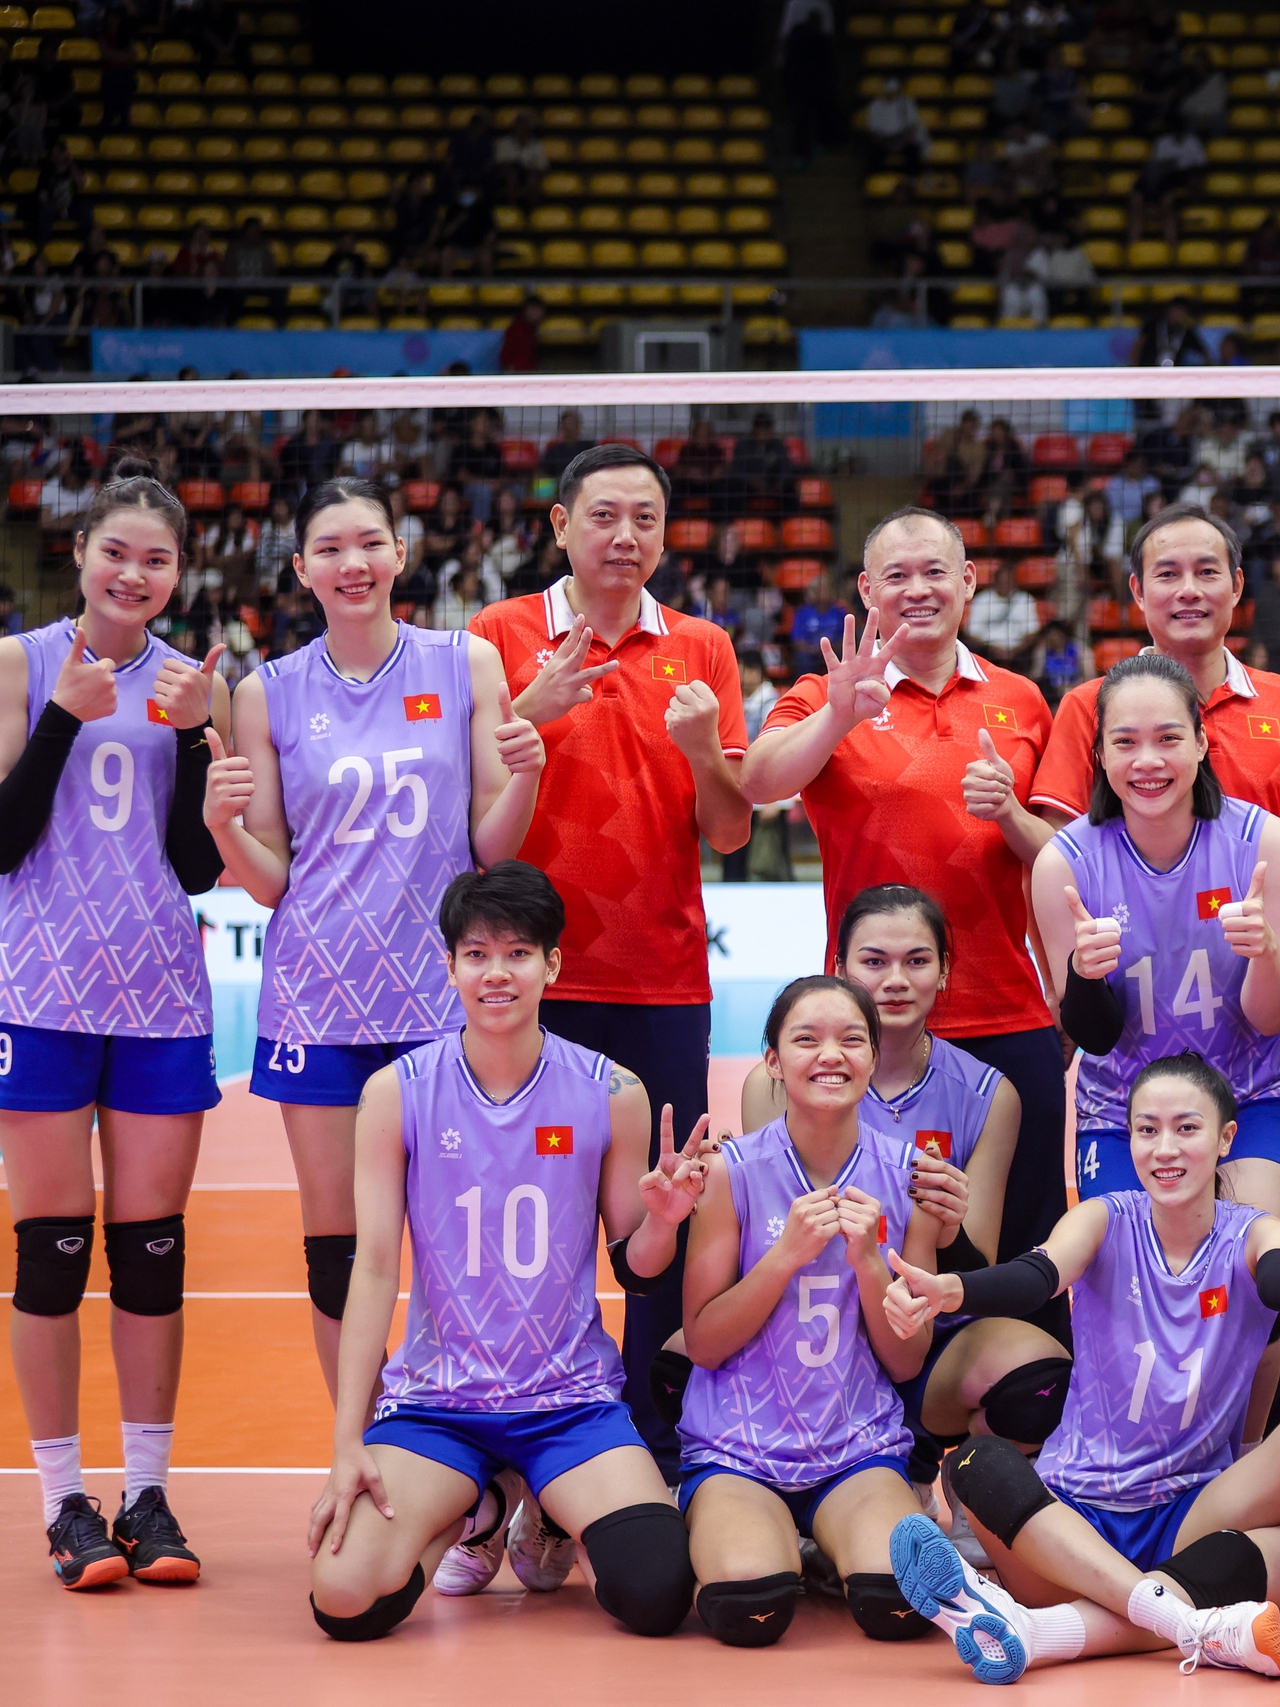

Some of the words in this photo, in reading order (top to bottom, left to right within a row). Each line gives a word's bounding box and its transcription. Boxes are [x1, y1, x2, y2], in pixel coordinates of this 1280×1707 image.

[89, 741, 135, 832] 9
[328, 746, 430, 846] 25
[1125, 948, 1223, 1036] 14
[455, 1184, 550, 1279] 10
[796, 1275, 842, 1368] 5
[1126, 1338, 1205, 1431] 11
